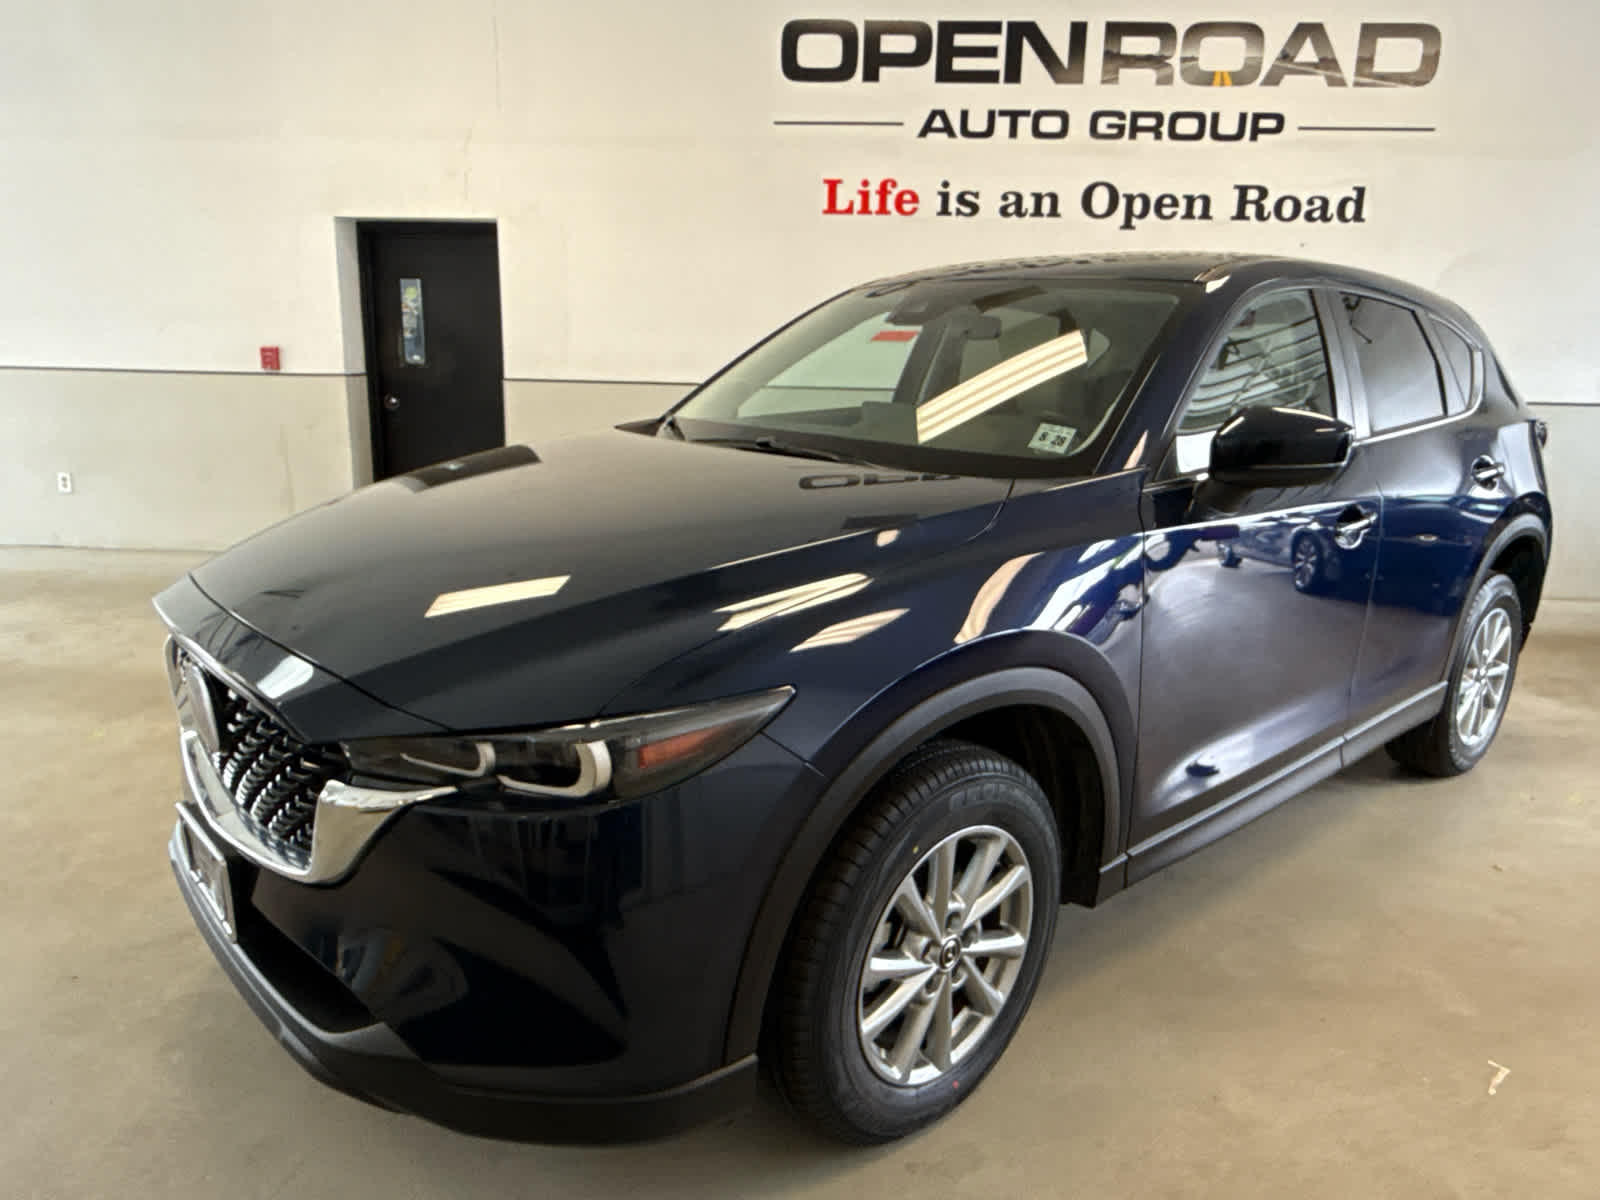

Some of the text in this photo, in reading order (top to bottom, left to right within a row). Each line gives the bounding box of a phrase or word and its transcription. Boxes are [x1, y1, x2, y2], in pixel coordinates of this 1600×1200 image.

[779, 18, 1443, 88] OPEN ROAD
[917, 108, 1286, 142] AUTO GROUP
[822, 178, 1367, 230] Life is an Open Road
